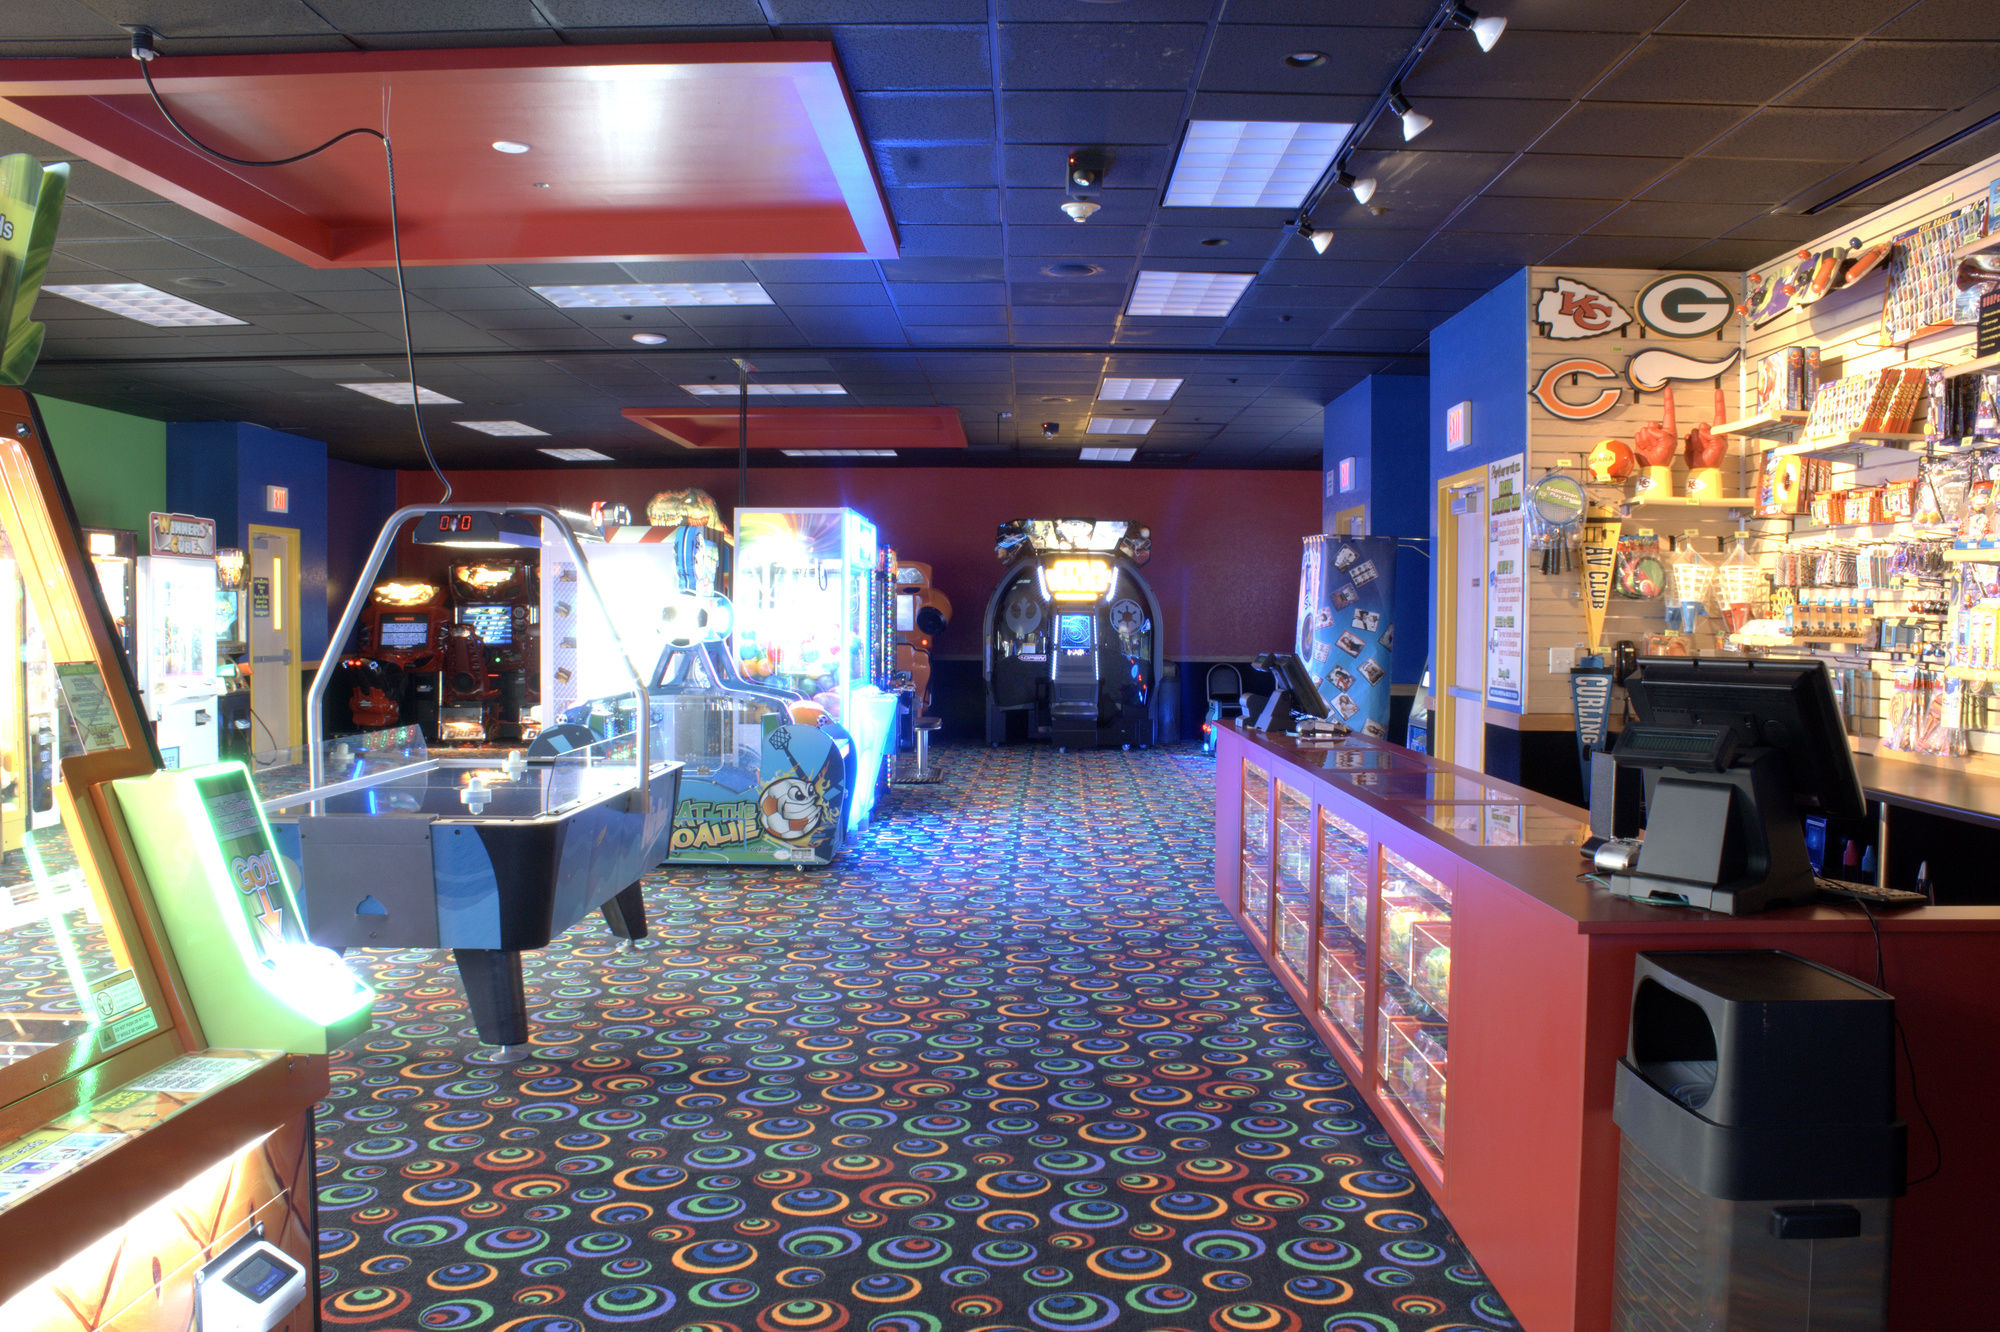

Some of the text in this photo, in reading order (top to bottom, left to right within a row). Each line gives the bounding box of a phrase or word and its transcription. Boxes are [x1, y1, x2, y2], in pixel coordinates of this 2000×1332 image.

[1558, 291, 1613, 331] KC
[1642, 277, 1730, 335] G
[1528, 357, 1623, 421] C
[273, 488, 287, 509] EXIT
[461, 515, 472, 530] 0
[1585, 546, 1613, 610] AV CLUB
[1575, 676, 1609, 744] CURLING
[446, 730, 481, 738] DRIFT
[716, 801, 758, 823] THE
[670, 820, 761, 850] OALIE
[232, 850, 280, 894] GO!!
